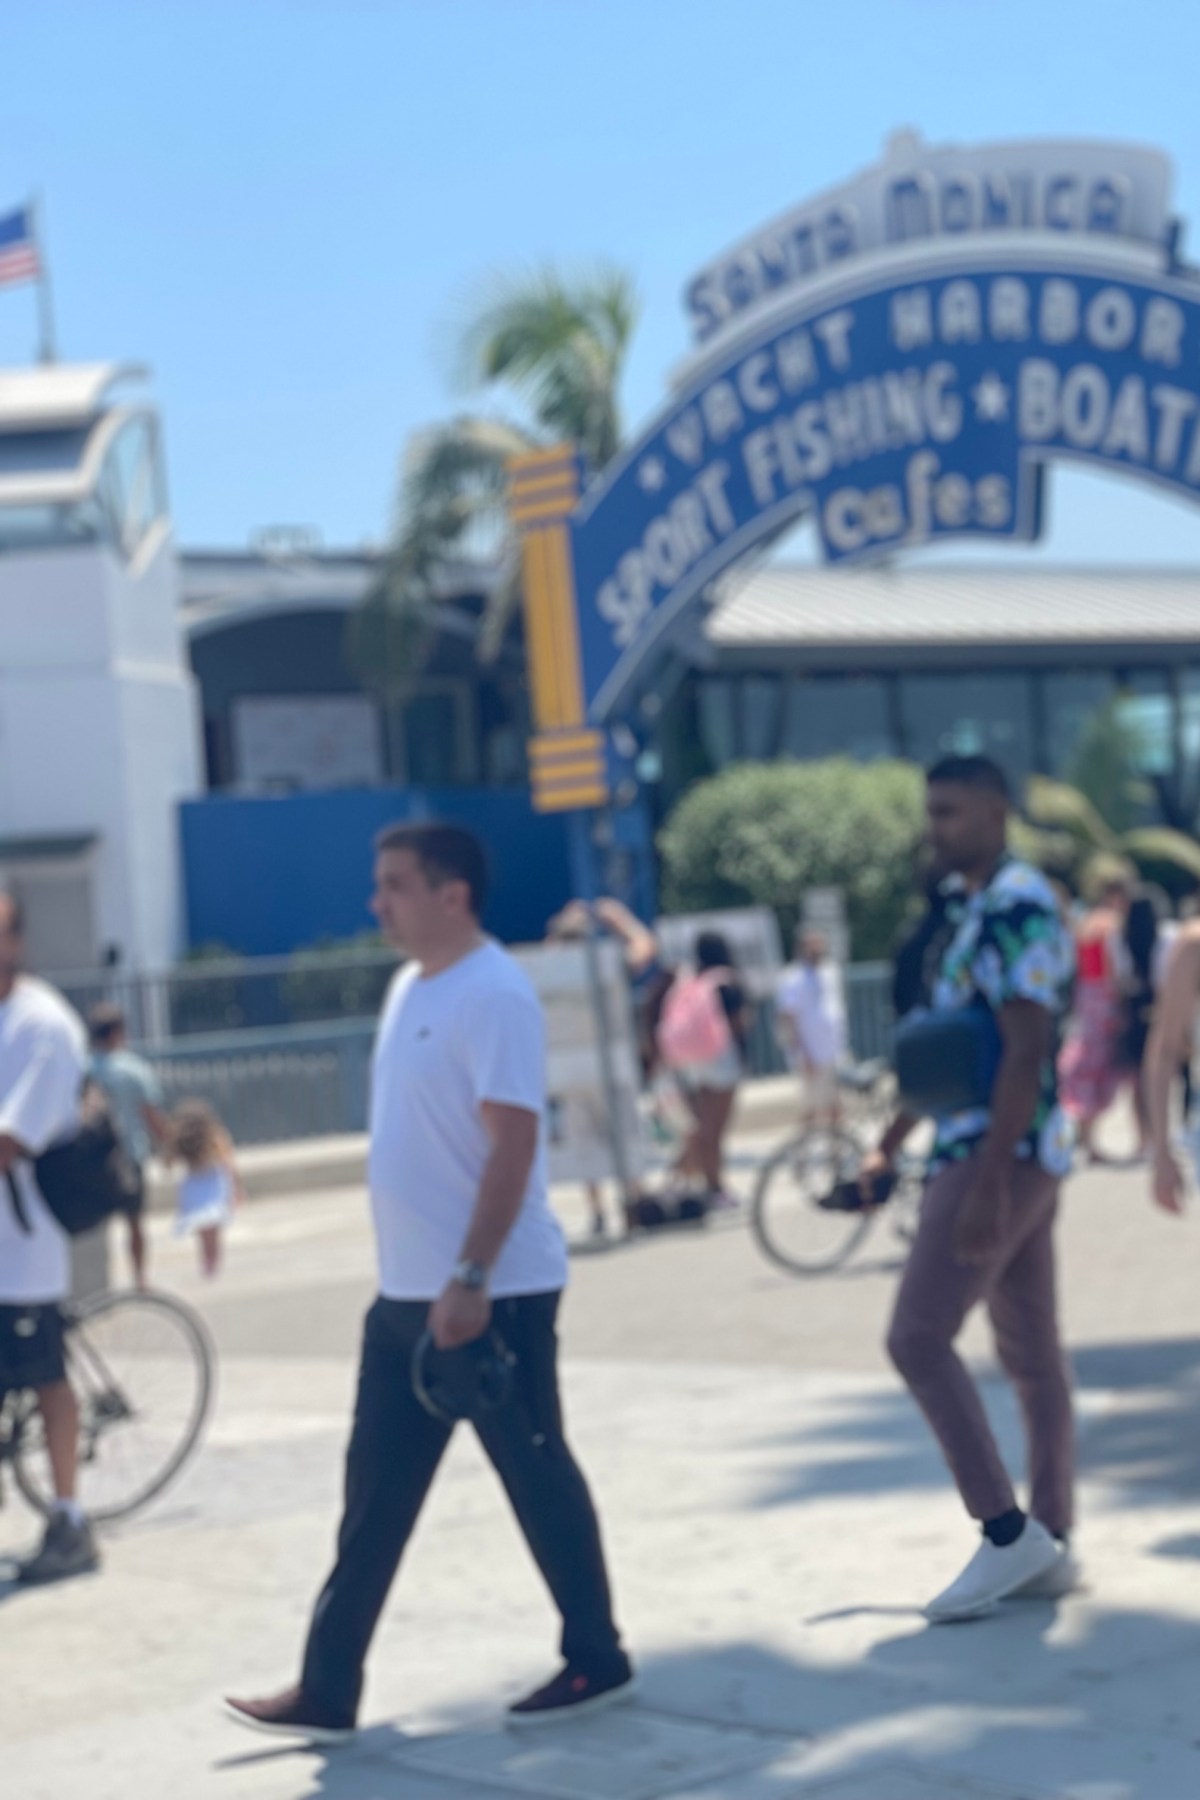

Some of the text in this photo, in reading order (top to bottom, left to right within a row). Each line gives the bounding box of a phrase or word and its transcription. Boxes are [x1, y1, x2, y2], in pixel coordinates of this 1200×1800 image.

[686, 169, 1131, 338] SANTA MONICA
[664, 276, 1185, 467] YACHT HARBOR
[596, 459, 736, 648] SPORT
[743, 359, 963, 508] FISHING
